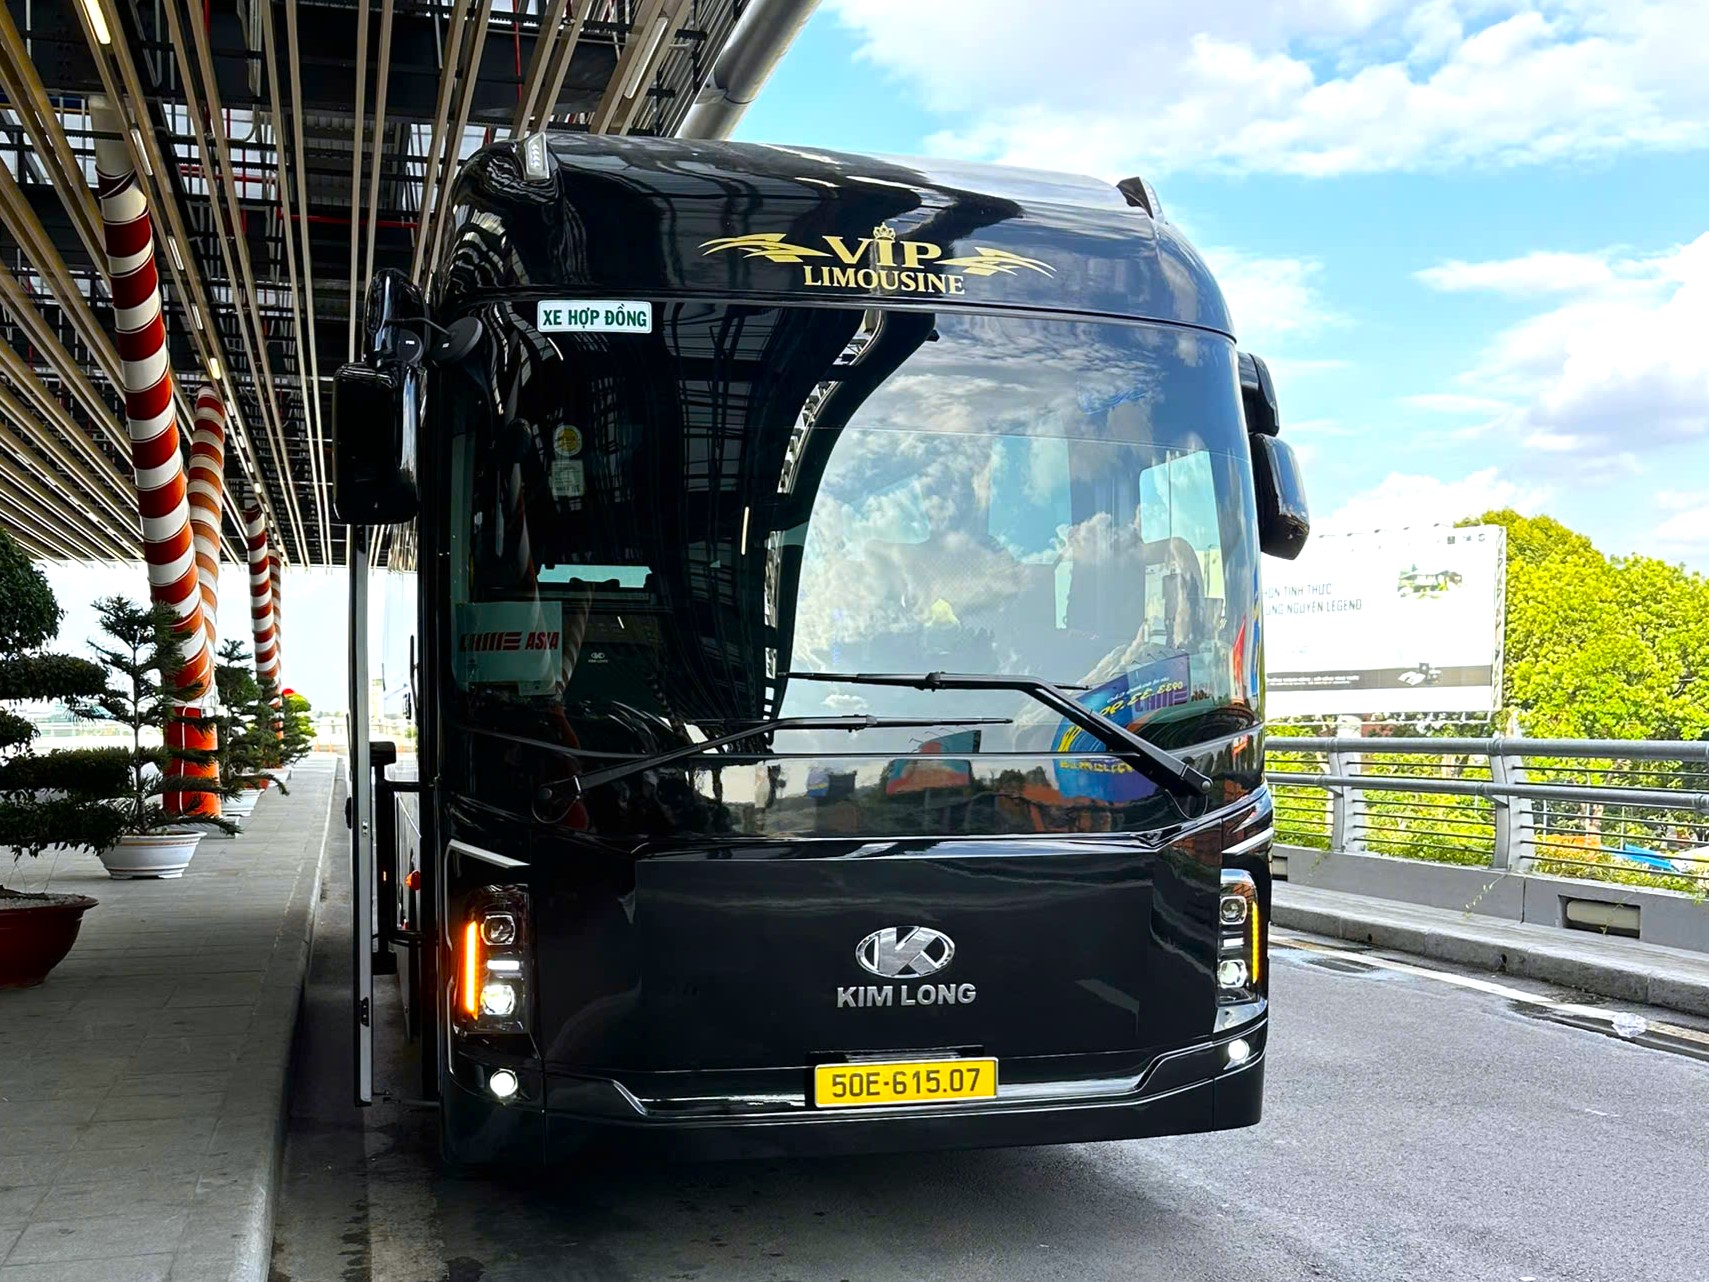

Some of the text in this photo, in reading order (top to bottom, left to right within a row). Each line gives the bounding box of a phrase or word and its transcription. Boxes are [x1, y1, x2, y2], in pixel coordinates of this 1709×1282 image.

[822, 235, 942, 269] VIP
[803, 265, 965, 295] LIMOUSINE
[543, 303, 647, 328] XE HỢP ĐỒNG
[1327, 598, 1362, 613] LEGEND
[837, 983, 976, 1008] KIM LONG
[832, 1068, 980, 1098] 50E-615.07
